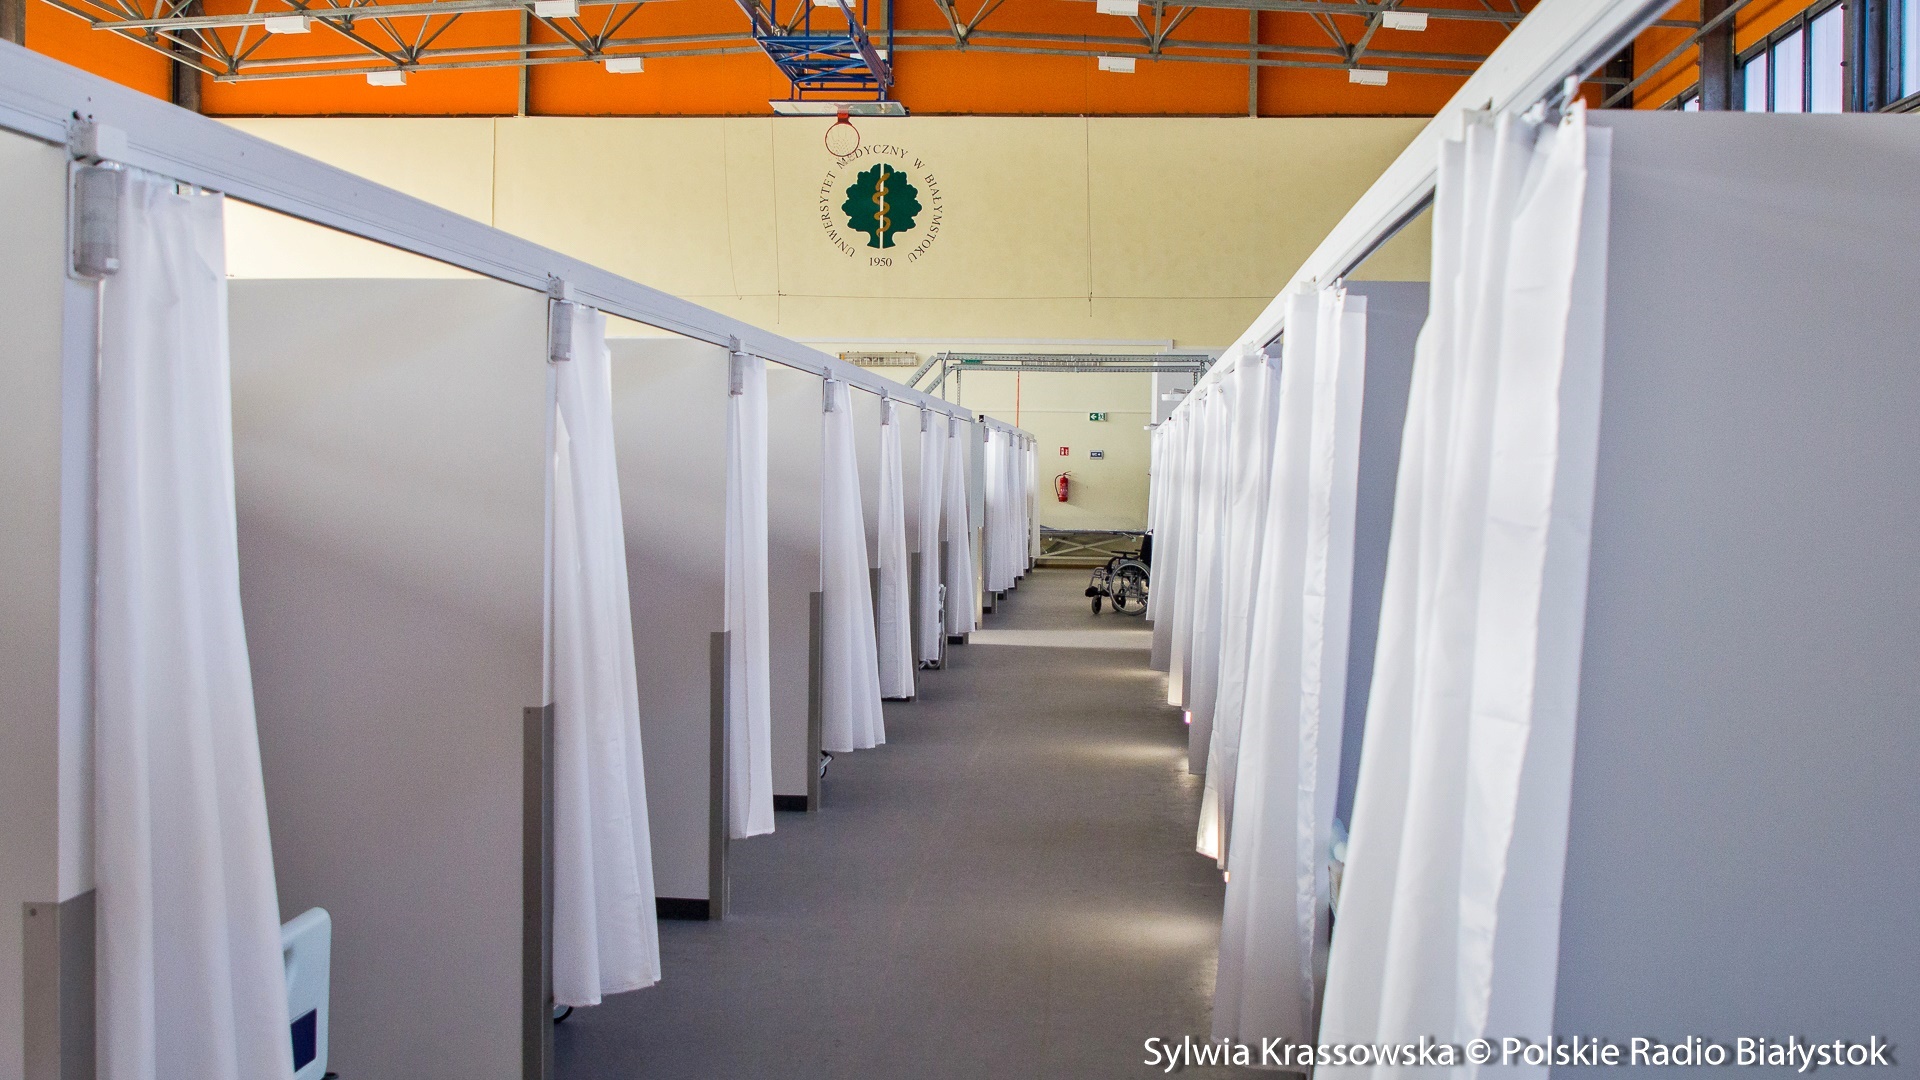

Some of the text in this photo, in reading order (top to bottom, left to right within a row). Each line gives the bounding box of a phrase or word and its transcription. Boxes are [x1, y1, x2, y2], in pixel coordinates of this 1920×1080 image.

[820, 144, 943, 263] UNIWERSYTET MEDYCZNY W BIAŁYMSTOKU
[869, 257, 893, 267] 1950
